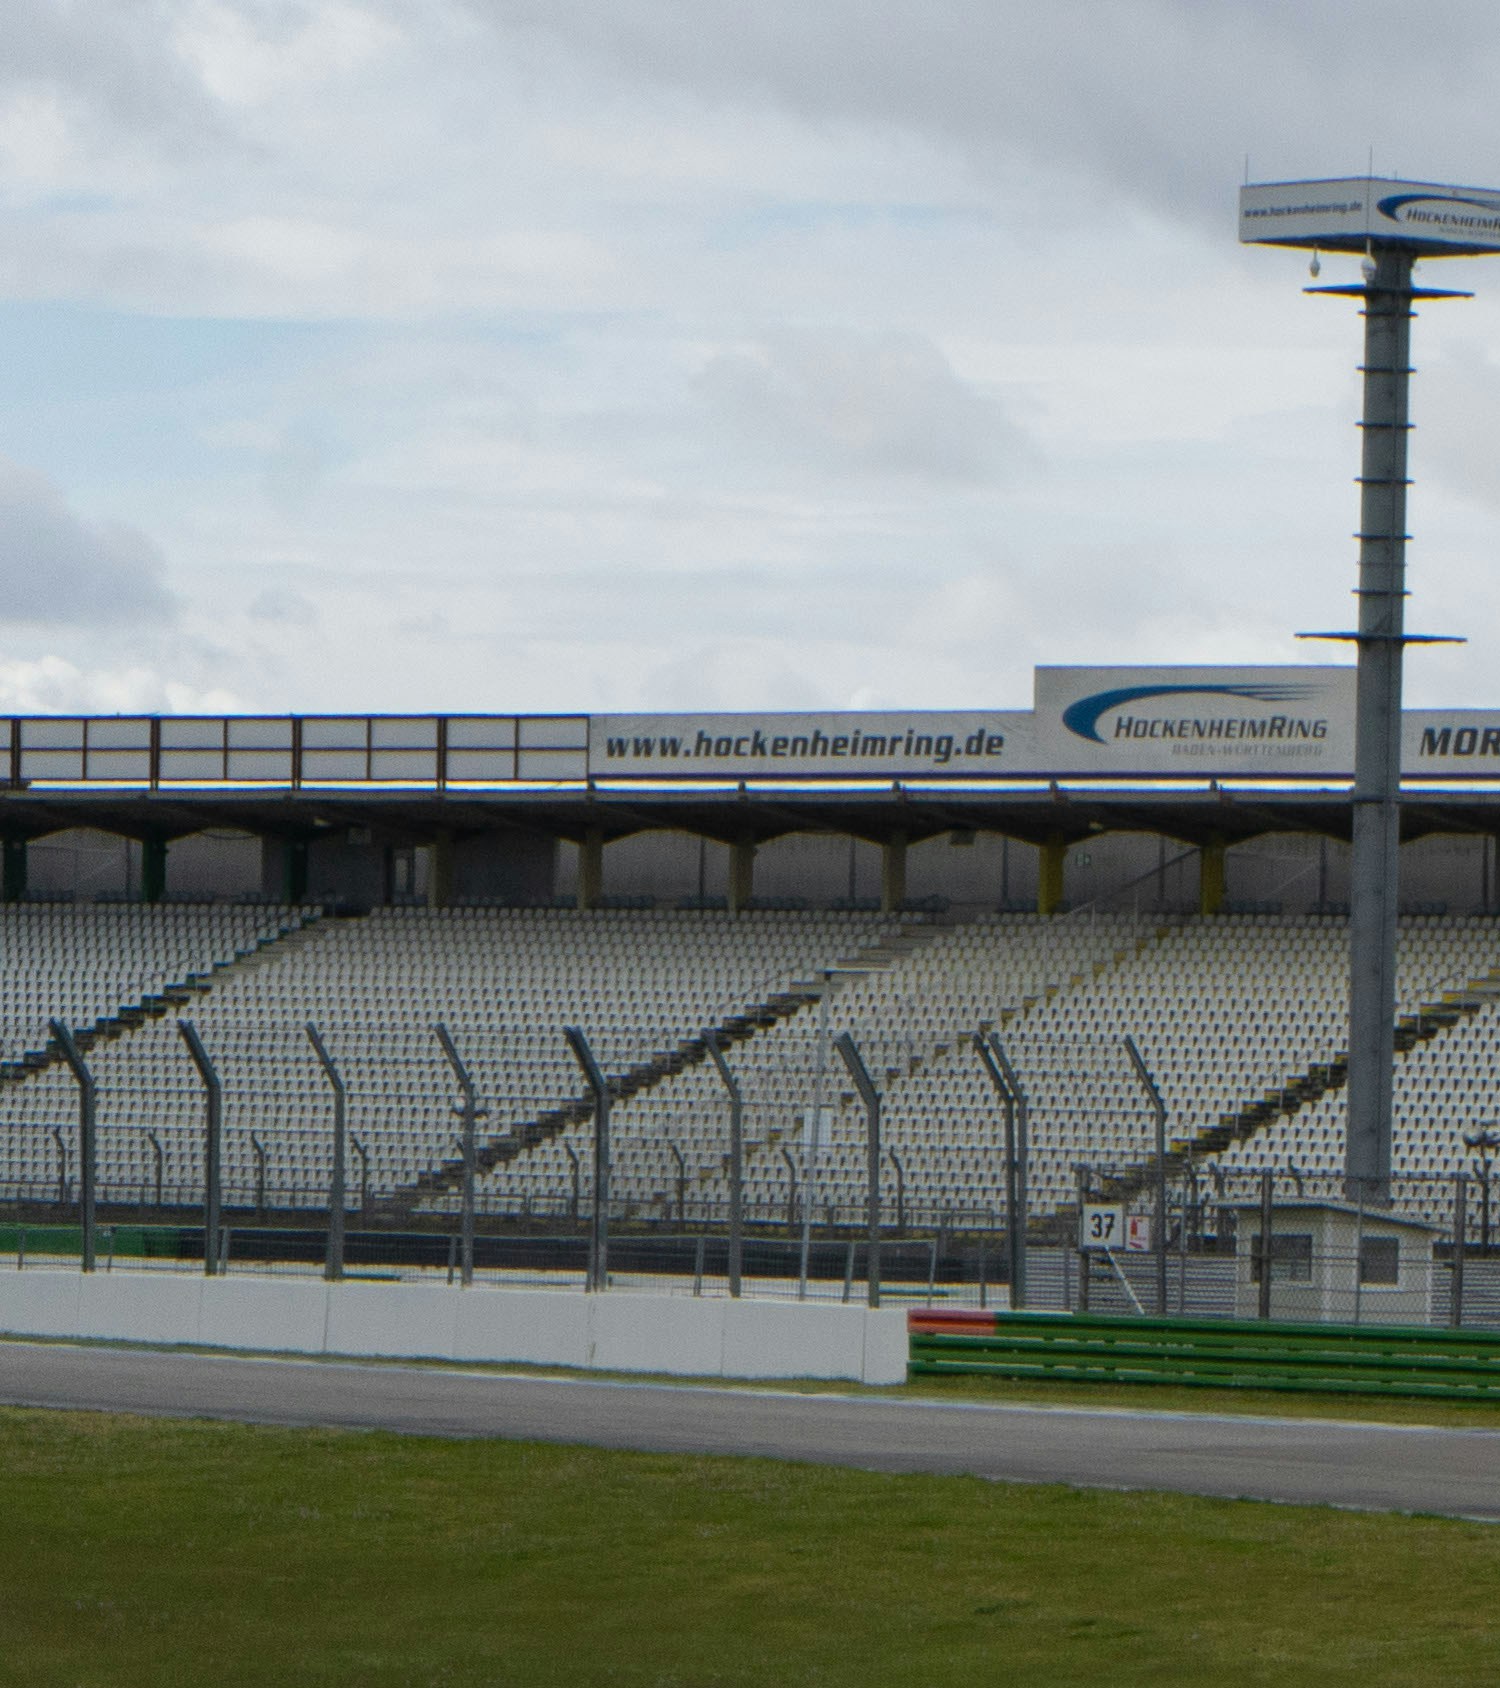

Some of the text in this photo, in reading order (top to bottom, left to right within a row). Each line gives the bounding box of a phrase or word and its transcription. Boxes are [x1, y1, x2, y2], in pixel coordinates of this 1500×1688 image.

[1114, 715, 1328, 739] HOCKENHEIMRING
[606, 729, 1004, 765] www.hockenheimring.de
[1090, 1213, 1115, 1240] 37
